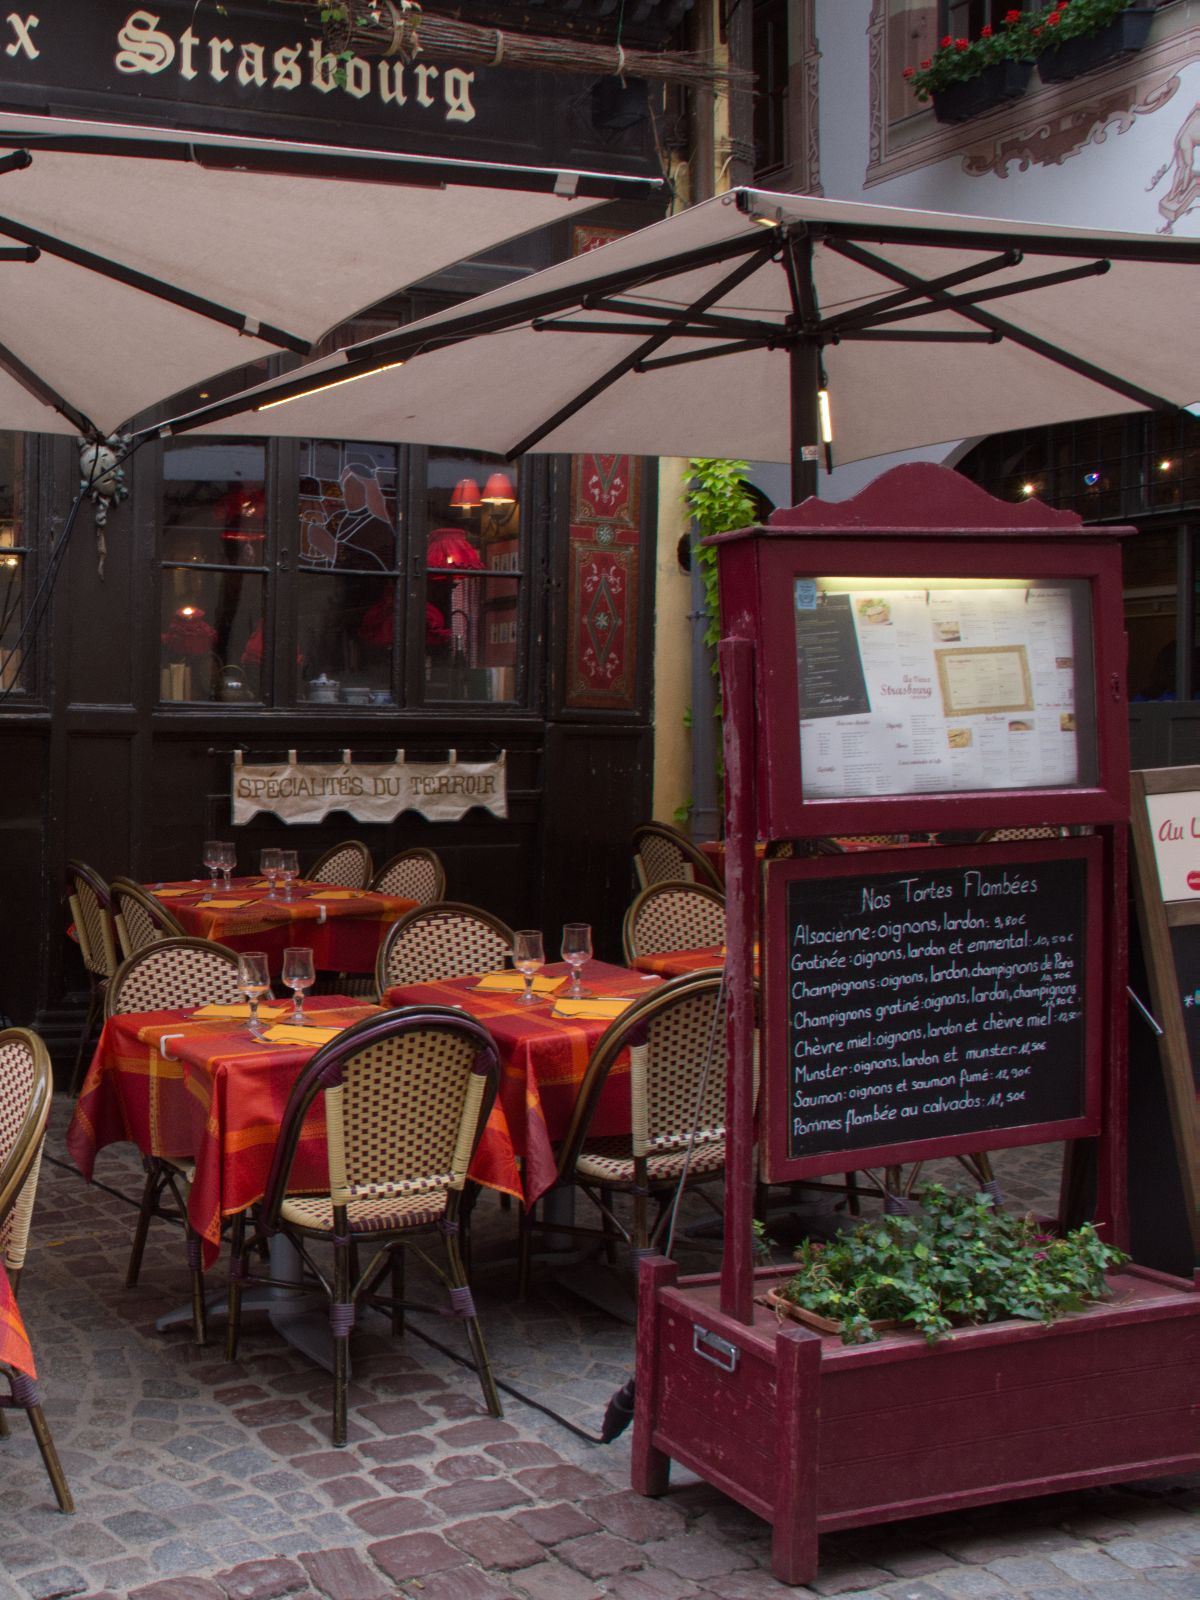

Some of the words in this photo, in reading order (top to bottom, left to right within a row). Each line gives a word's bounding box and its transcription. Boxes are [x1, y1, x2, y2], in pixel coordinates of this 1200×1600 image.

[116, 10, 475, 122] Strasbourg
[237, 770, 363, 798] SPÉCIALITÉS
[373, 776, 400, 797] DU
[410, 775, 497, 795] TERROIR
[862, 887, 891, 912] Nos
[899, 878, 953, 902] Tartes
[964, 870, 1038, 897] Flambées
[907, 939, 945, 958] lardon
[948, 938, 964, 954] et
[971, 961, 1039, 980] champignons
[1040, 954, 1052, 971] de
[1054, 952, 1074, 969] Paris
[794, 1007, 872, 1030] Champignons
[1013, 983, 1077, 1001] champignons
[794, 1037, 844, 1058] Chèvre
[927, 1019, 963, 1037] lardon
[965, 1018, 978, 1032] et
[983, 1012, 1024, 1031] chèvre
[902, 1049, 939, 1067] lardon
[944, 1046, 958, 1063] et
[849, 1083, 892, 1100] oignons
[896, 1079, 907, 1092] et
[912, 1074, 955, 1089] saumon
[793, 1117, 842, 1137] Pommes
[845, 1103, 897, 1134] flambée
[901, 1105, 918, 1118] au
